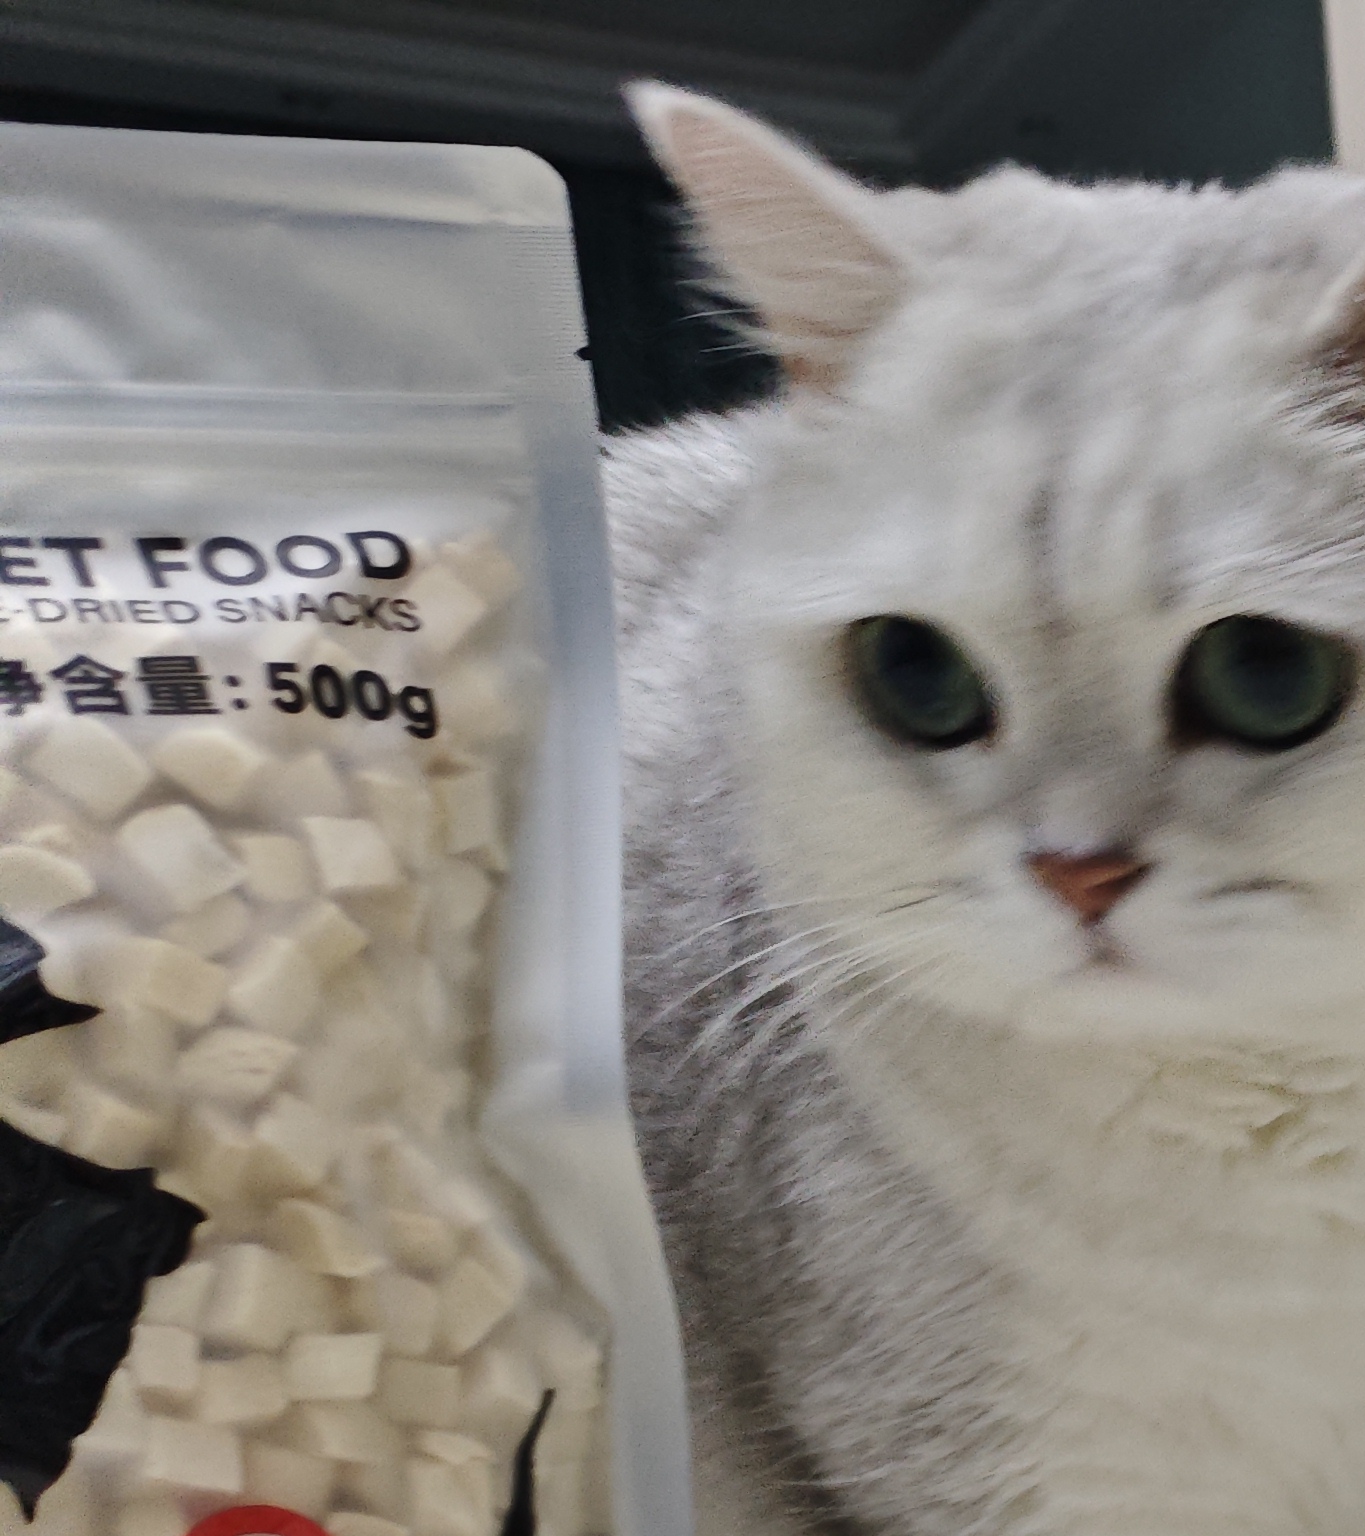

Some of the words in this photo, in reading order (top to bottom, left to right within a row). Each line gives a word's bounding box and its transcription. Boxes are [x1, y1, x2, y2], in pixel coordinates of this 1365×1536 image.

[134, 530, 411, 588] FOOD
[0, 597, 200, 625] -DRIED
[217, 591, 422, 633] SNACKS
